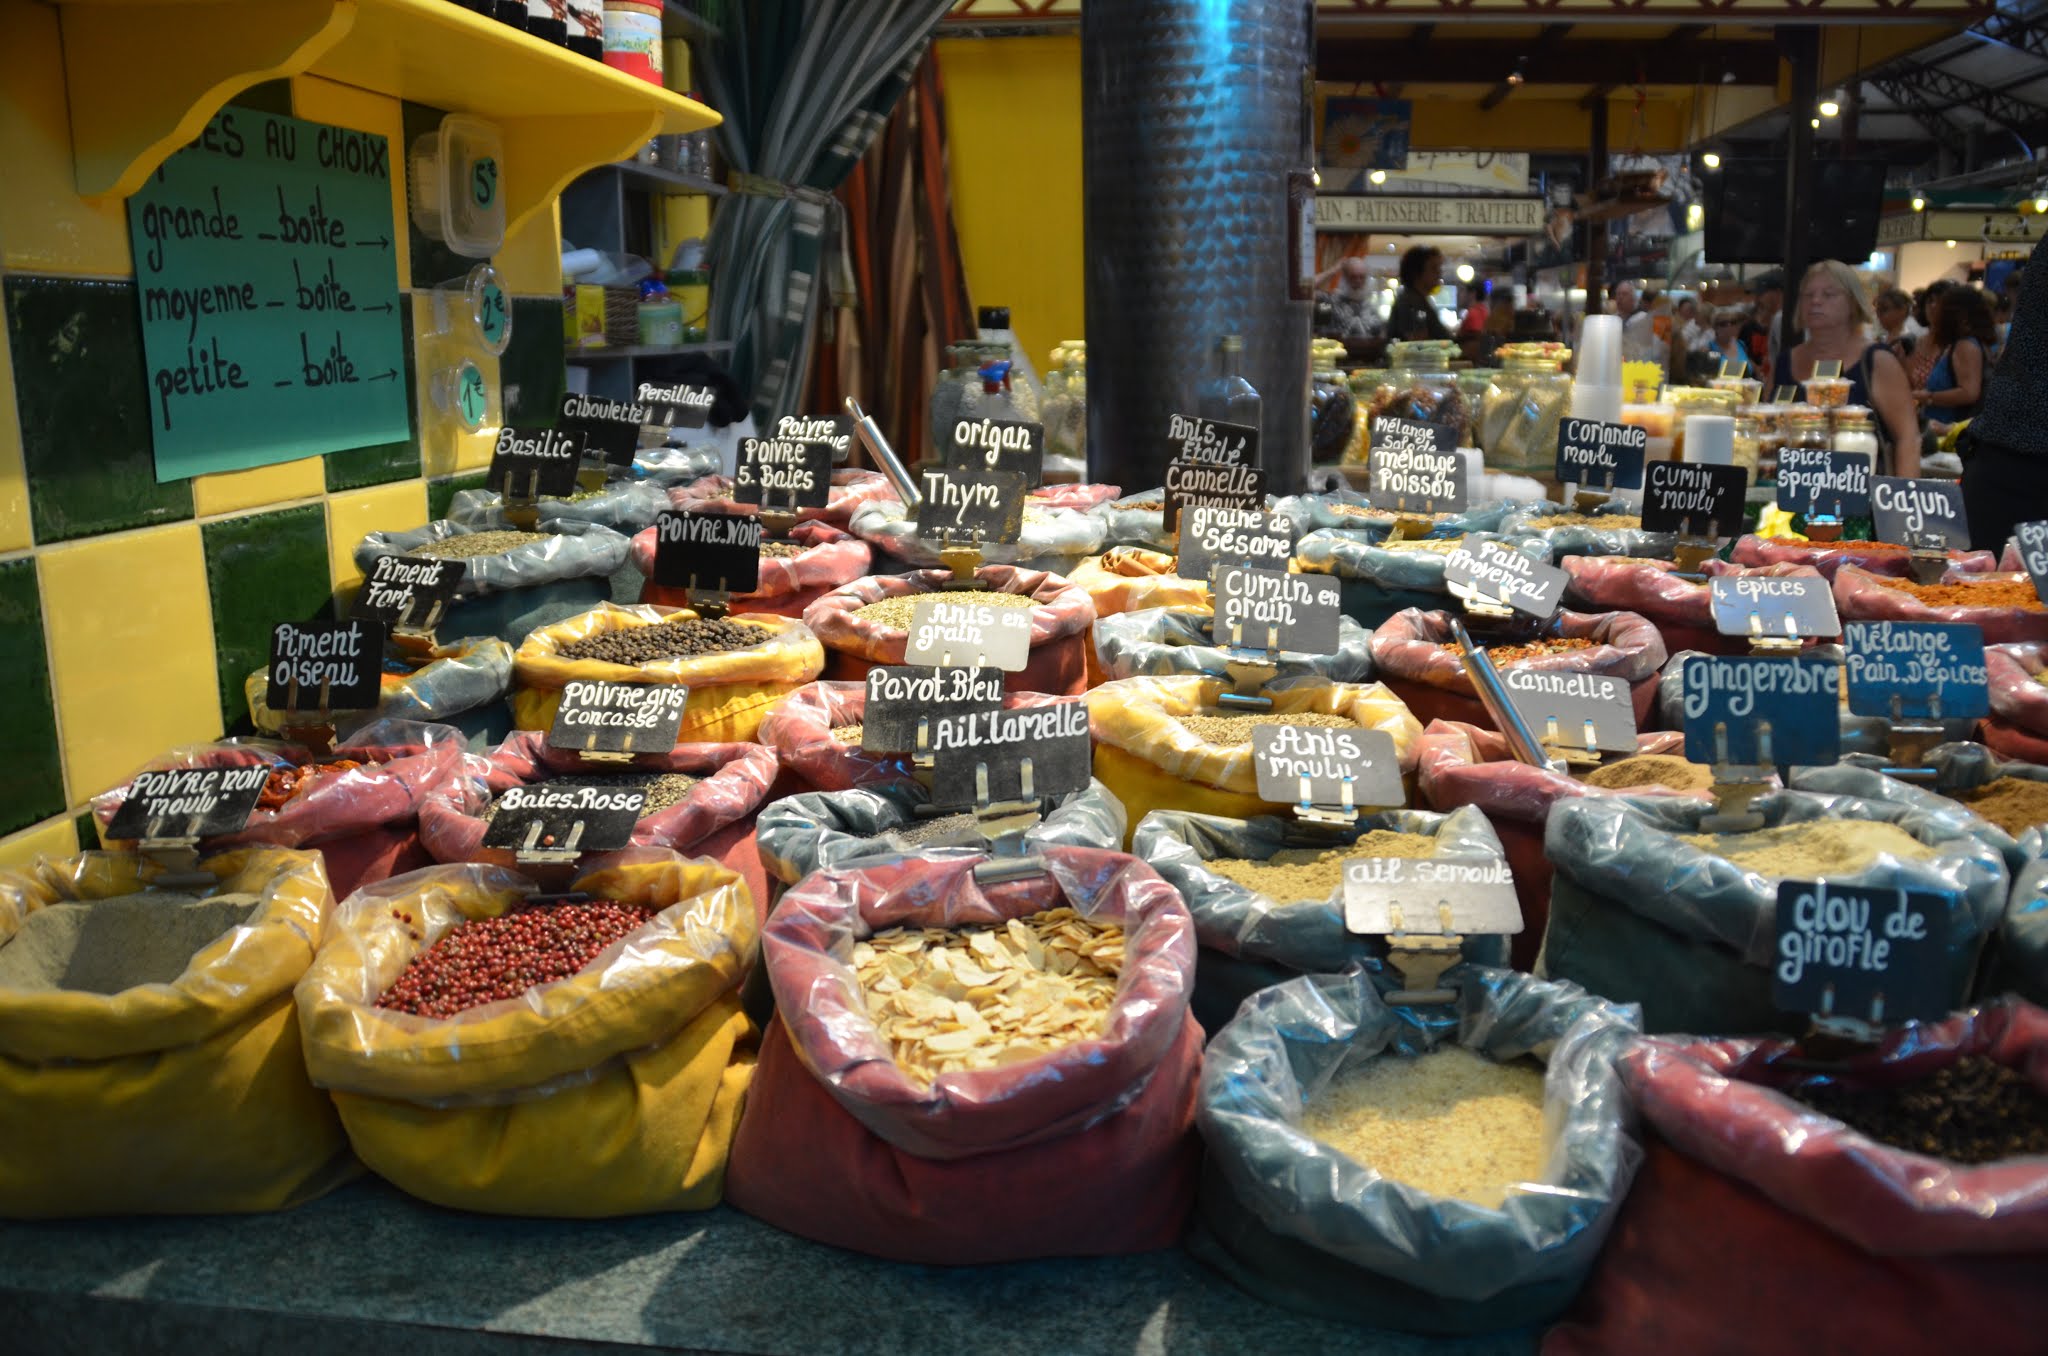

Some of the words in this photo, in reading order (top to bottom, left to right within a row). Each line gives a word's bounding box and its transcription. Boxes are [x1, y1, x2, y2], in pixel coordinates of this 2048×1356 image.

[266, 119, 295, 161] AU
[143, 185, 243, 272] grande
[1316, 203, 1342, 224] AIN
[1456, 203, 1537, 224] TRAITEUR
[145, 283, 259, 343] moyenne
[155, 336, 249, 431] petite
[638, 382, 715, 407] Persillade
[496, 428, 574, 459] Basilic
[1375, 416, 1435, 444] Mélange
[1567, 420, 1647, 448] Coriandre
[1563, 444, 1618, 468] moulu
[760, 464, 814, 490] Baies
[1166, 466, 1259, 496] Cannelle
[923, 473, 1000, 525] Thym
[1875, 481, 1956, 532] Cajun
[1192, 507, 1263, 538] graine
[1269, 514, 1291, 534] de
[372, 555, 444, 586] Piment
[1479, 541, 1533, 576] Pain
[366, 580, 413, 610] Fort
[1318, 589, 1340, 607] en
[1713, 580, 1728, 600] 4
[1736, 577, 1806, 602] épices
[927, 603, 995, 627] Anis
[1002, 612, 1028, 629] en
[1225, 597, 1296, 630] grain
[275, 620, 363, 658] Piment
[915, 622, 984, 651] grain
[1845, 622, 1951, 666] Mélange
[1507, 669, 1615, 700] Cannelle
[1685, 656, 1839, 719] gingembre
[1270, 726, 1361, 759] Anis
[219, 764, 269, 791] noir
[1885, 888, 1927, 940] de
